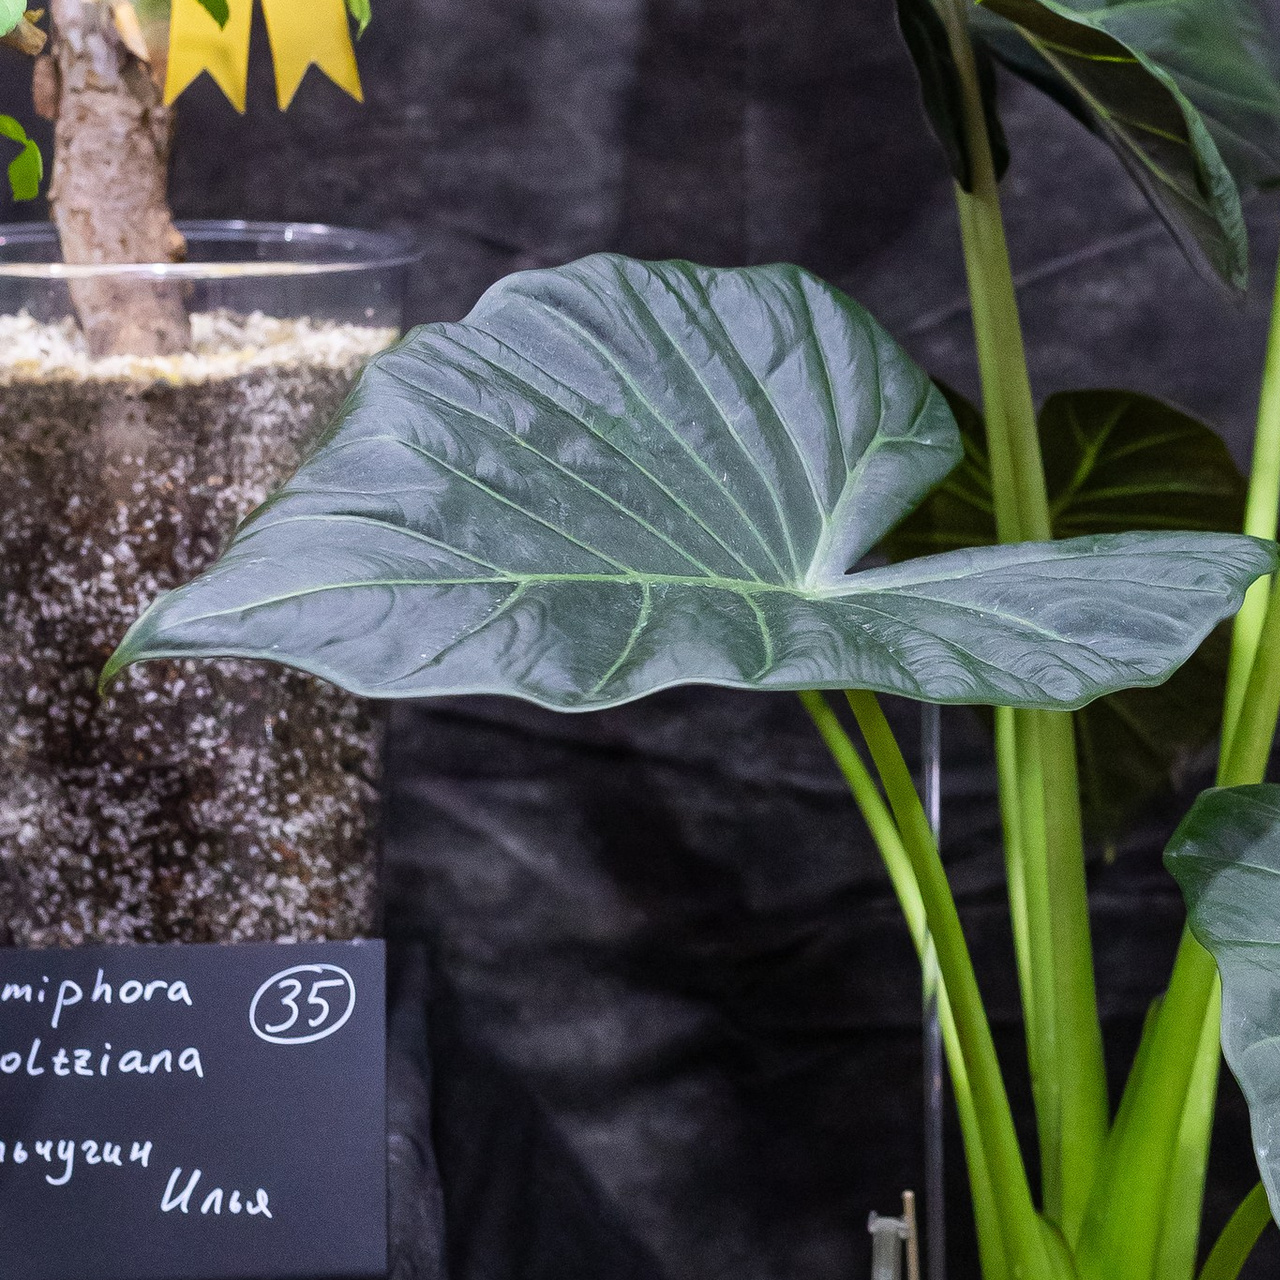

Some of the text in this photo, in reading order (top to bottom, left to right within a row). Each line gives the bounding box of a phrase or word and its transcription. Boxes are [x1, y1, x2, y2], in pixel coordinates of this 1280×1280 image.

[0, 968, 193, 1029] miphora
[264, 978, 345, 1034] 35
[160, 1166, 273, 1219] Илья
